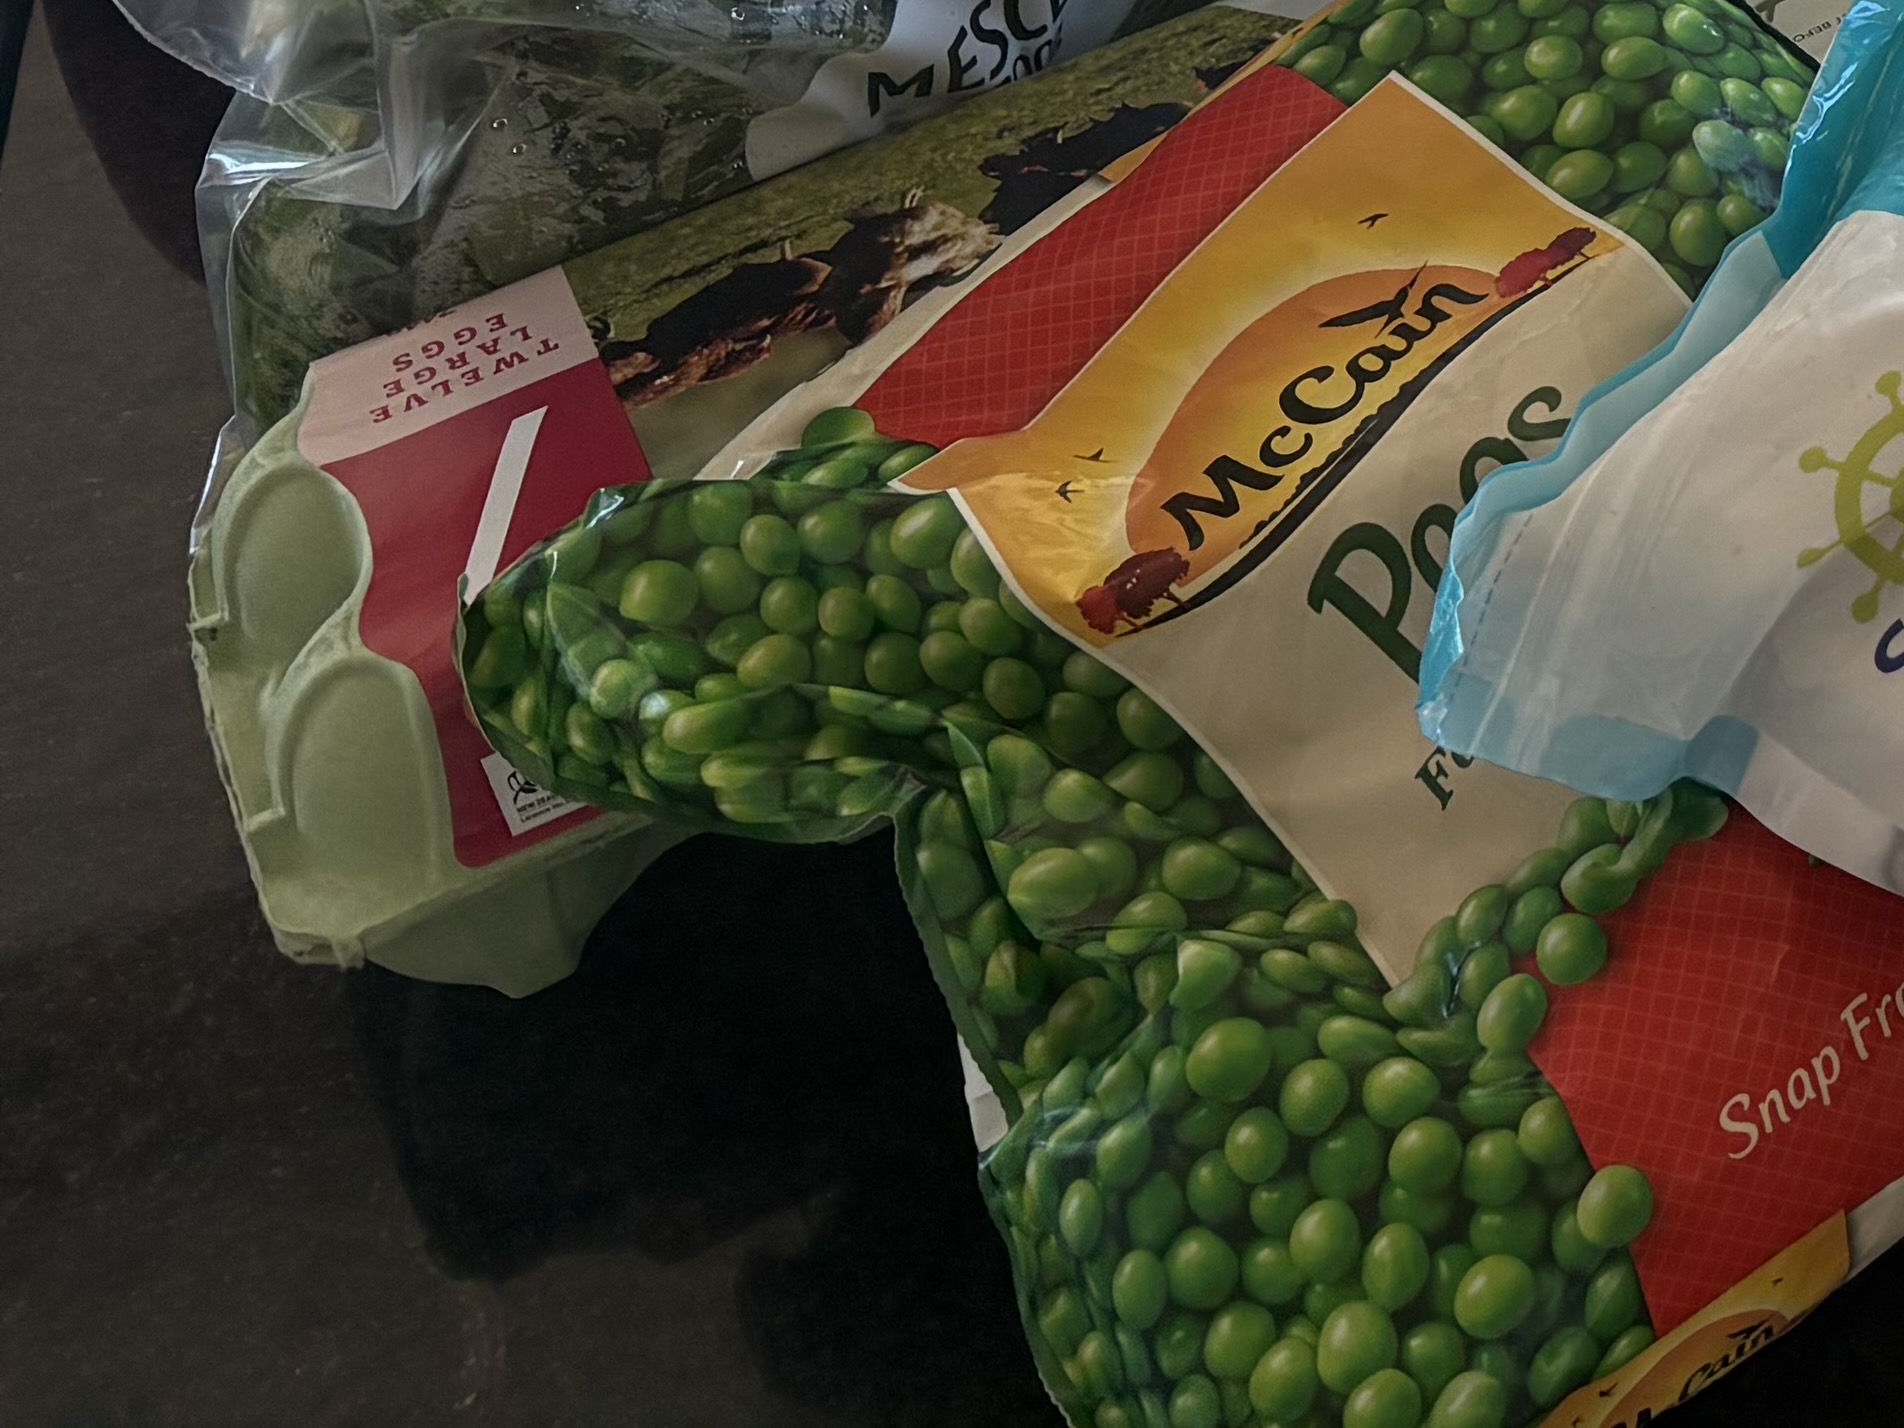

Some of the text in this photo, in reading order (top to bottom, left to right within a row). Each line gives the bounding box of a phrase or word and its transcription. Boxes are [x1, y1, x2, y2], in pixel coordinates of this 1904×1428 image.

[368, 337, 560, 425] TWELVE
[382, 325, 533, 399] LARGE
[391, 312, 509, 373] EGGS
[1161, 269, 1490, 552] McCain
[1717, 1044, 1844, 1161] Snap
